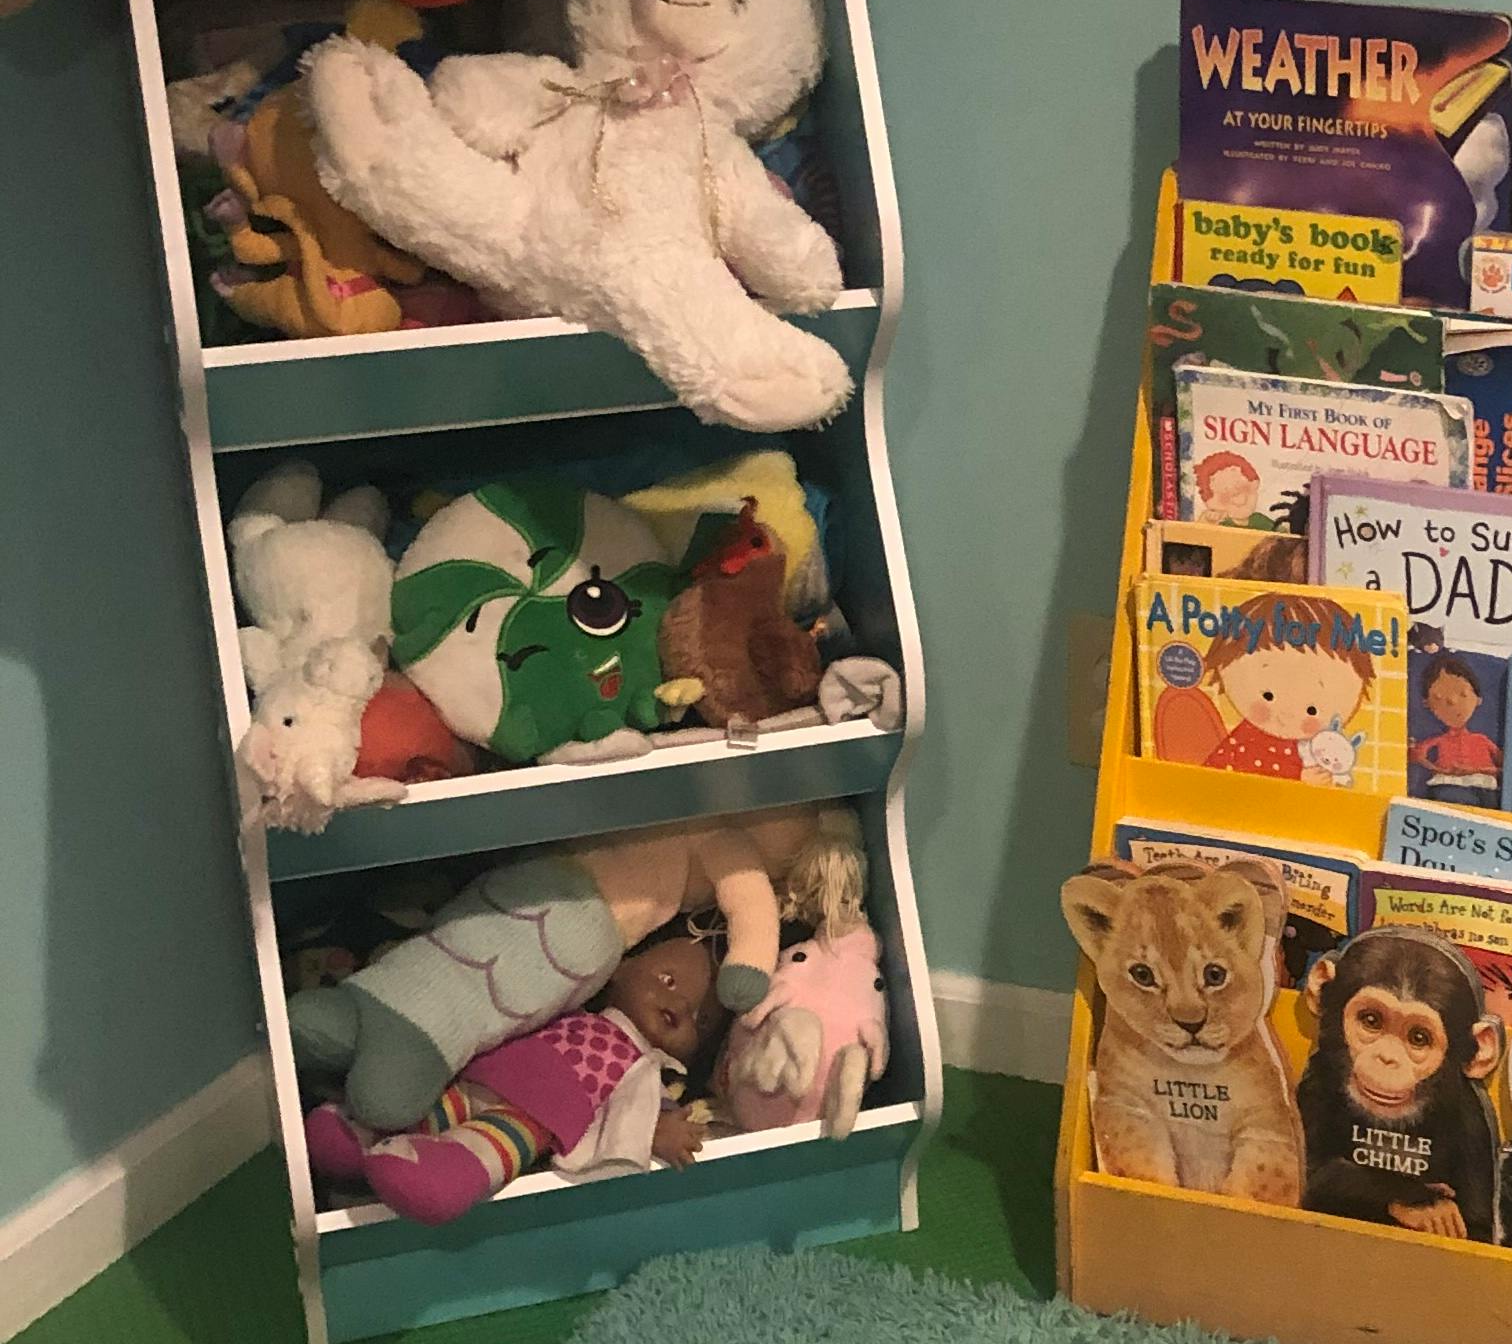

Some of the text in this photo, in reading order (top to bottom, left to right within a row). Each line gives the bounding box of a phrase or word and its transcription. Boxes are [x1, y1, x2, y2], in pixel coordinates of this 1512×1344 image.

[1192, 24, 1422, 105] WEATHER
[1222, 110, 1388, 140] AT YOUR FINGERTIPS
[1193, 211, 1399, 255] baby's book
[1210, 245, 1376, 279] ready for fun
[1202, 414, 1439, 466] SIGN LANGUAGE
[1333, 513, 1402, 550] How
[1424, 519, 1455, 544] to
[1365, 569, 1382, 590] a
[1147, 592, 1400, 658] A Potty for Me!
[1401, 814, 1486, 855] Spot's
[1281, 863, 1332, 900] Biting
[1388, 895, 1434, 914] Words
[1438, 899, 1466, 916] Are
[1471, 903, 1495, 922] Not
[1468, 931, 1484, 943] no
[1487, 934, 1509, 947] son
[1152, 1077, 1231, 1102] LITTLE
[1169, 1100, 1219, 1122] LION
[1352, 1125, 1432, 1156] LITTLE
[1352, 1147, 1430, 1177] CHIMP
